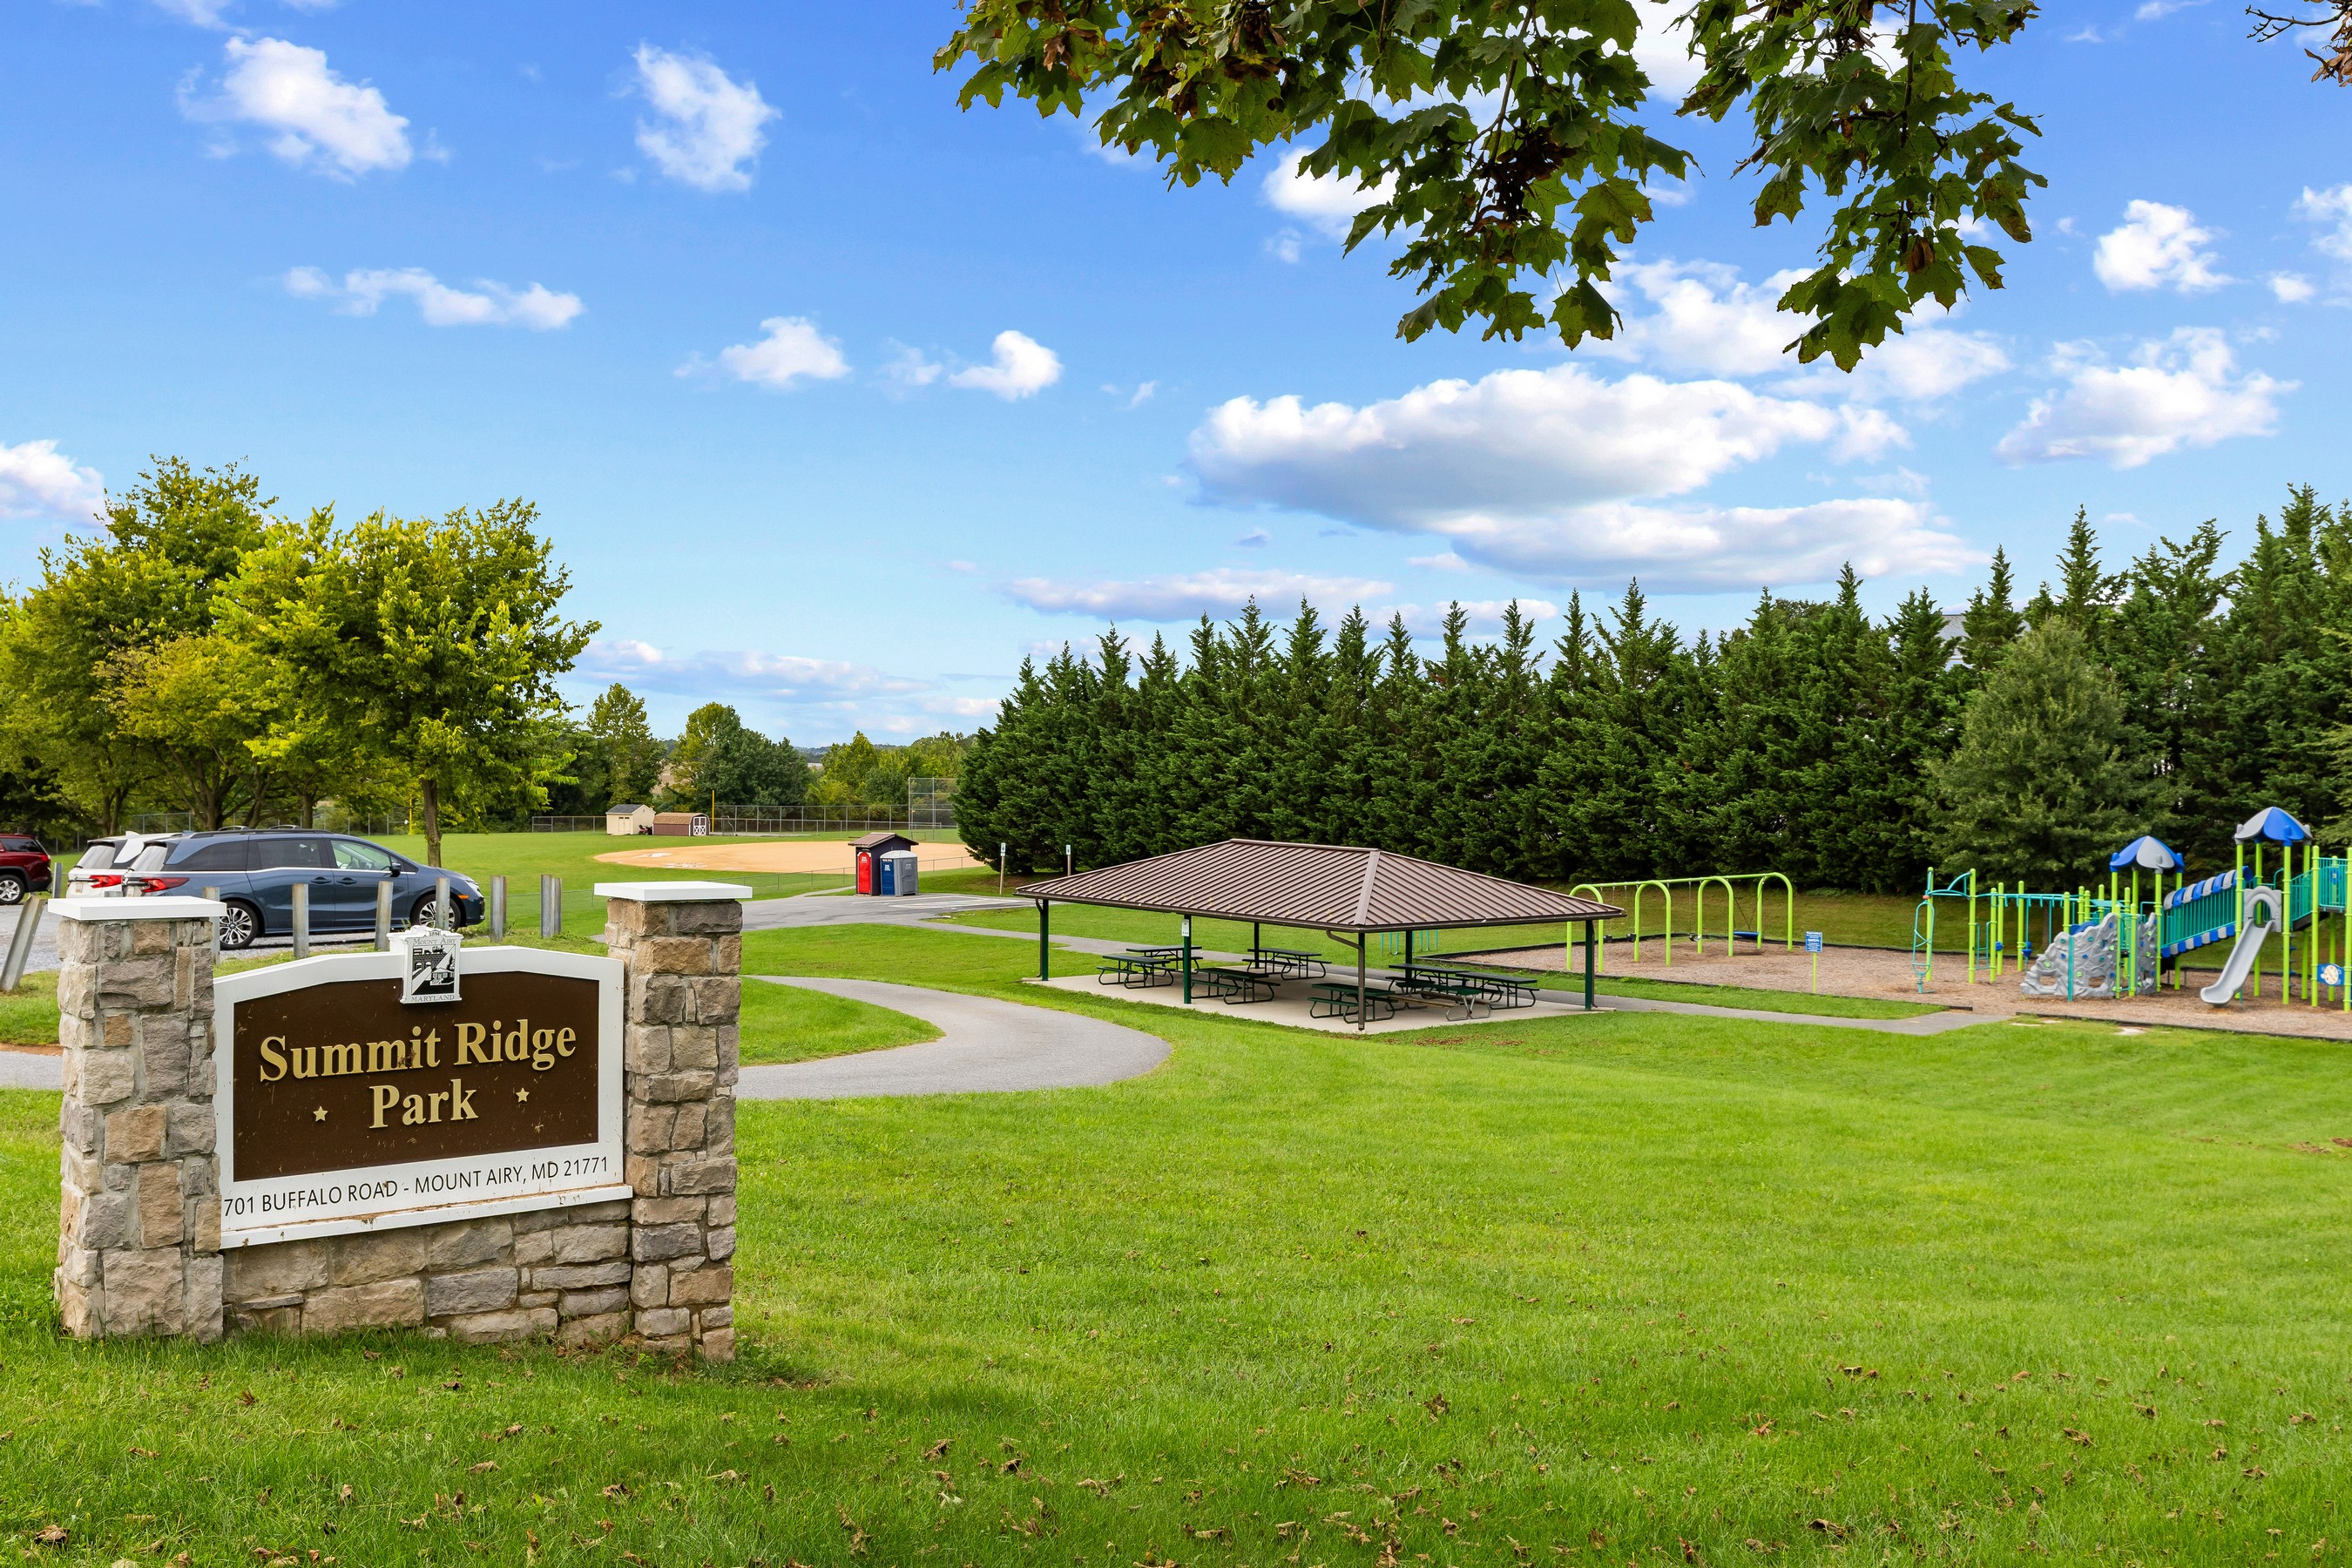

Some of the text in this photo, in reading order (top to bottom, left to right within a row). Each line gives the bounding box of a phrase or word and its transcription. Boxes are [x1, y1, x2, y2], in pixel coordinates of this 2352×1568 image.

[260, 1019, 577, 1082] Summit Ridge
[368, 1078, 478, 1129] Park
[224, 1196, 254, 1217] 701
[262, 1186, 342, 1212] BUFFALO
[348, 1180, 397, 1201] ROAD
[415, 1170, 482, 1194] MOUNT
[486, 1166, 527, 1186] AIRY,
[531, 1161, 558, 1180] MD
[564, 1156, 608, 1176] 21771
